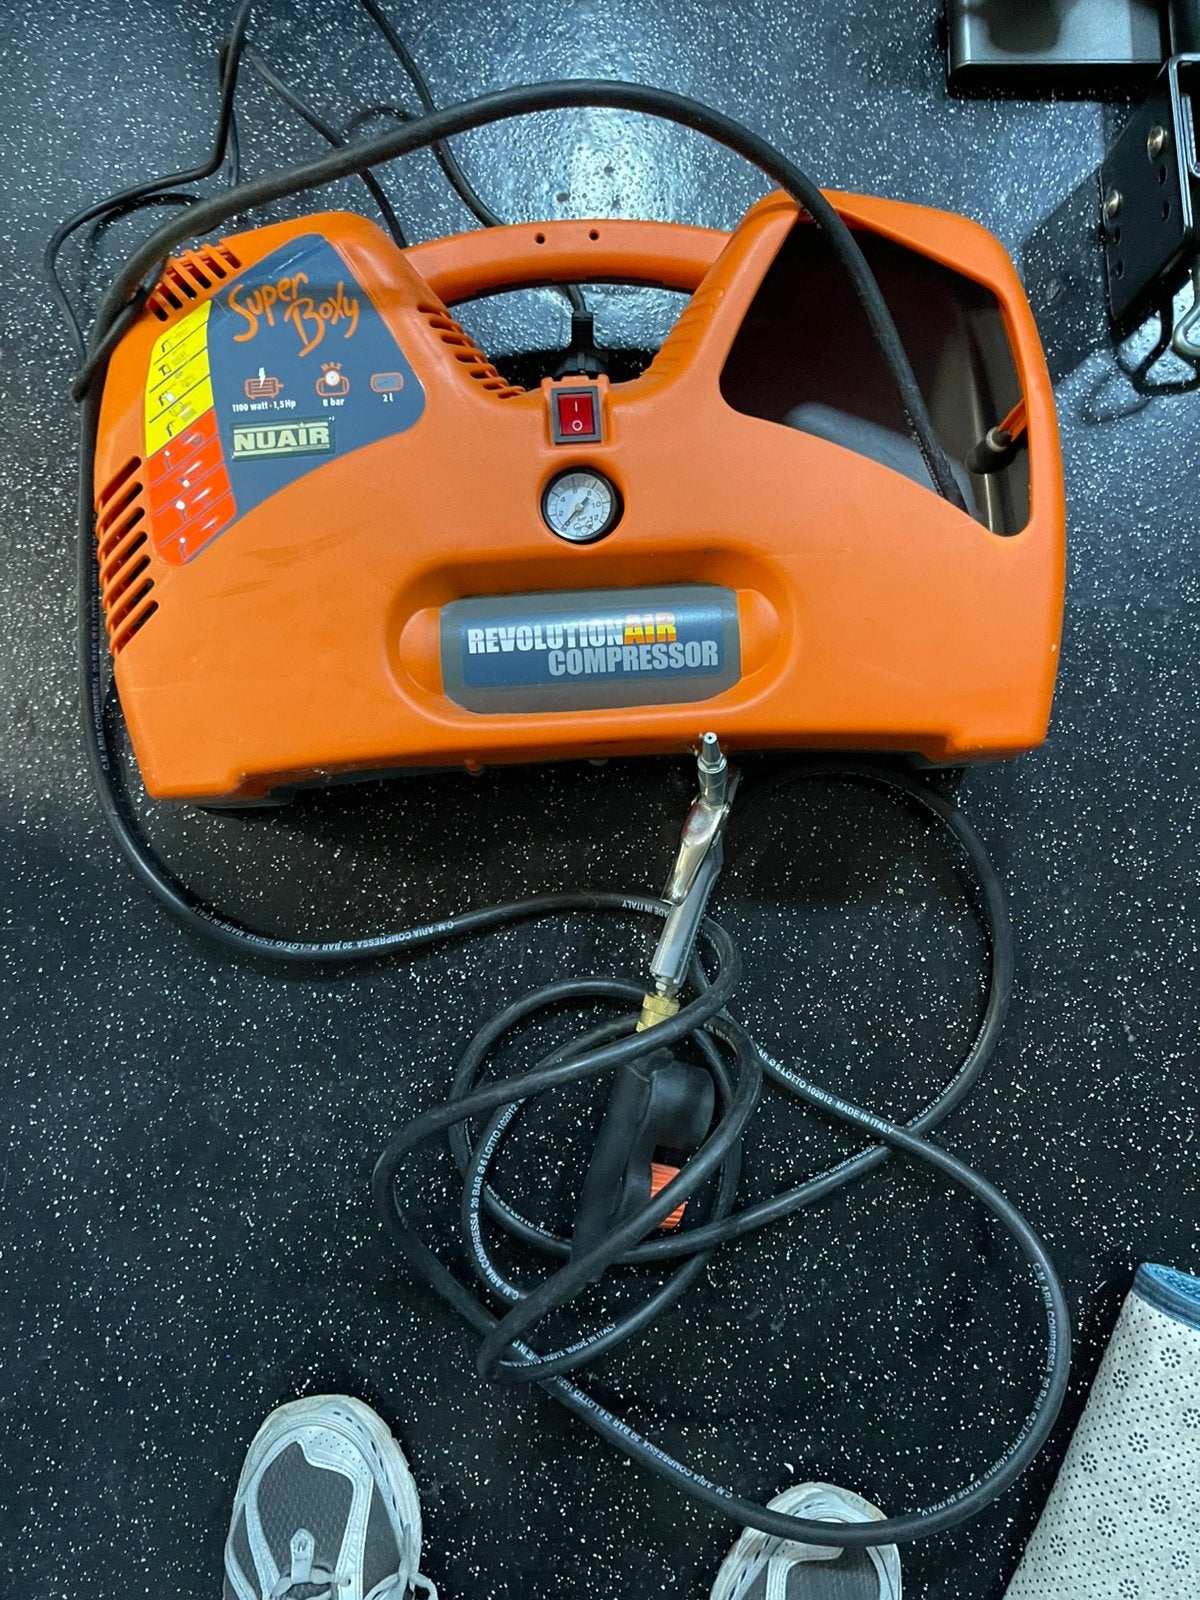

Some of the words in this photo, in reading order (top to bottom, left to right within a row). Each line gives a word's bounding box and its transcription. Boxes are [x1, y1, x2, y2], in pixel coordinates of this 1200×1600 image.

[228, 272, 309, 342] Super
[284, 281, 359, 358] Boxy
[232, 404, 249, 412] 1100
[250, 401, 268, 411] watt
[323, 398, 328, 406] 8
[330, 397, 345, 406] bar
[233, 422, 330, 451] NUAIR
[548, 640, 718, 677] COMPRESSOR
[622, 899, 643, 911] ITALY
[357, 932, 412, 948] COMPRESSA
[412, 928, 433, 938] ARIA
[781, 1067, 806, 1088] LOTTO
[806, 1085, 833, 1105] 102012
[835, 1101, 860, 1117] MADE
[860, 1110, 871, 1123] IN
[870, 1115, 894, 1135] ITALY
[497, 1103, 518, 1130] 102012
[482, 1130, 501, 1159] LOTTO
[472, 1176, 483, 1196] BAR
[470, 1197, 479, 1208] 20
[470, 1212, 489, 1268] COMPRESSA
[486, 1266, 503, 1287] ARIA
[1041, 1285, 1053, 1309] ARIA
[596, 1322, 616, 1338] ITALY
[1046, 1310, 1056, 1372] COMPRESSA
[573, 1390, 600, 1412] LOTTO
[613, 1419, 631, 1435] BAR
[643, 1440, 692, 1477] COMPRESSA
[693, 1474, 714, 1488] ARIA
[958, 1479, 982, 1500] MADE
